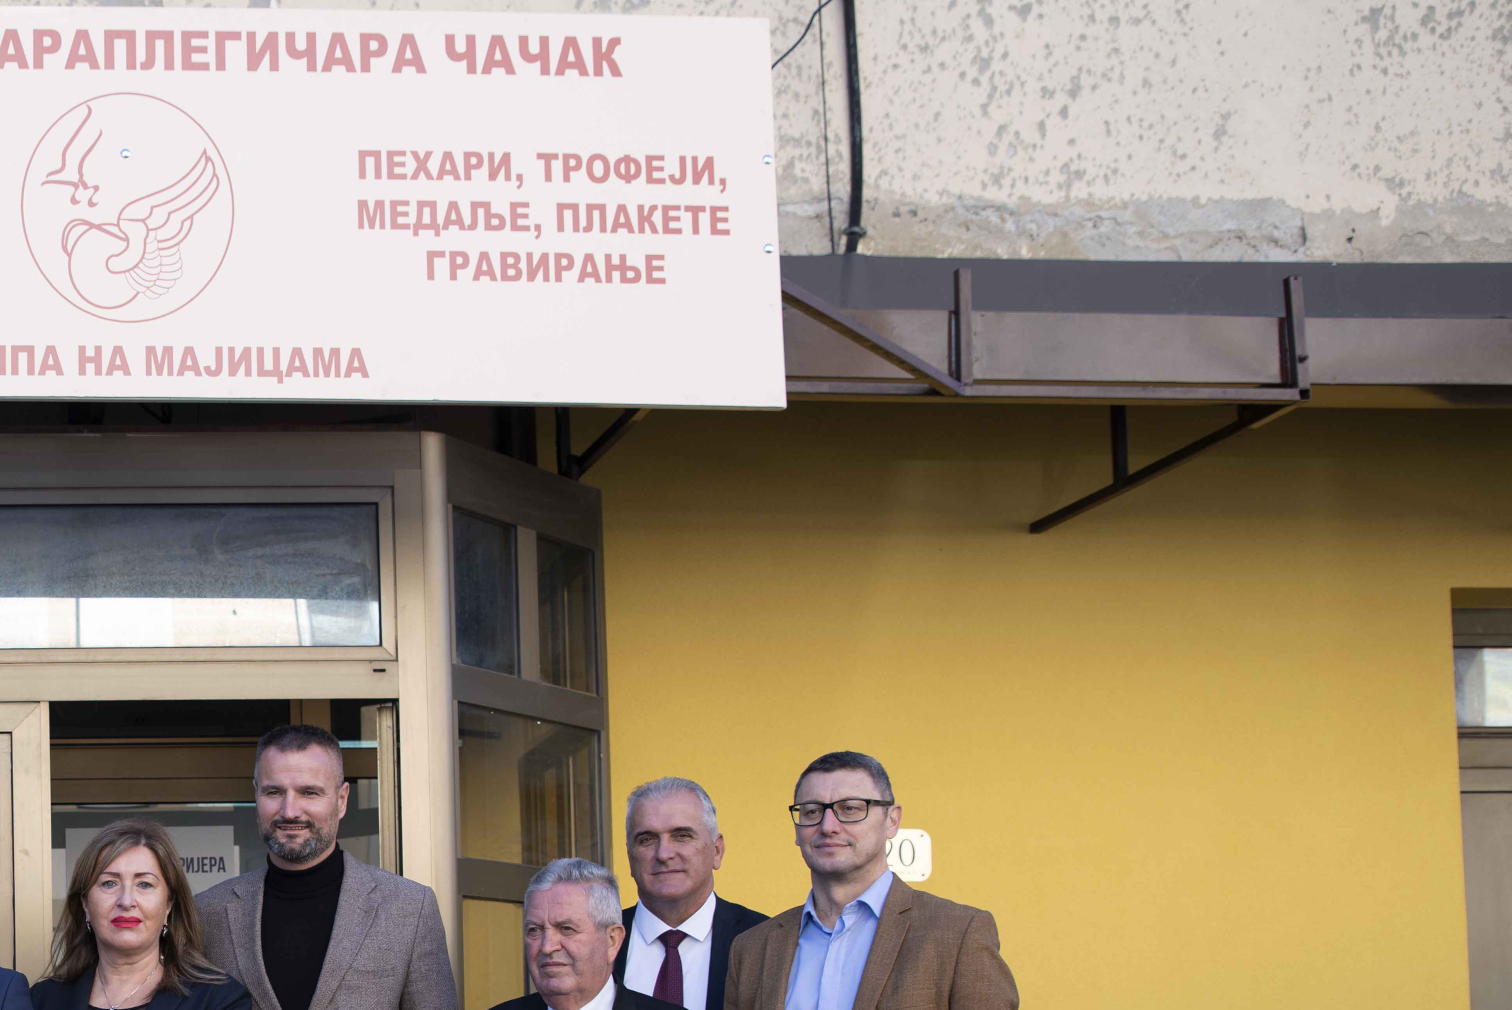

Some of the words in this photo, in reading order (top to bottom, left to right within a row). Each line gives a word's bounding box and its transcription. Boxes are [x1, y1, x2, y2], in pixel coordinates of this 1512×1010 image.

[445, 35, 623, 77] ЧАЧАК
[358, 150, 525, 189] ПЕХАРИ,
[536, 152, 728, 194] ТРОФЕЈИ,
[358, 200, 542, 240] МЕДАЉЕ,
[556, 203, 731, 237] ПЛАКЕТЕ
[426, 250, 667, 285] ГРАВИРАЊЕ
[78, 346, 132, 377] НА
[145, 346, 370, 384] МАЈИЦАМА
